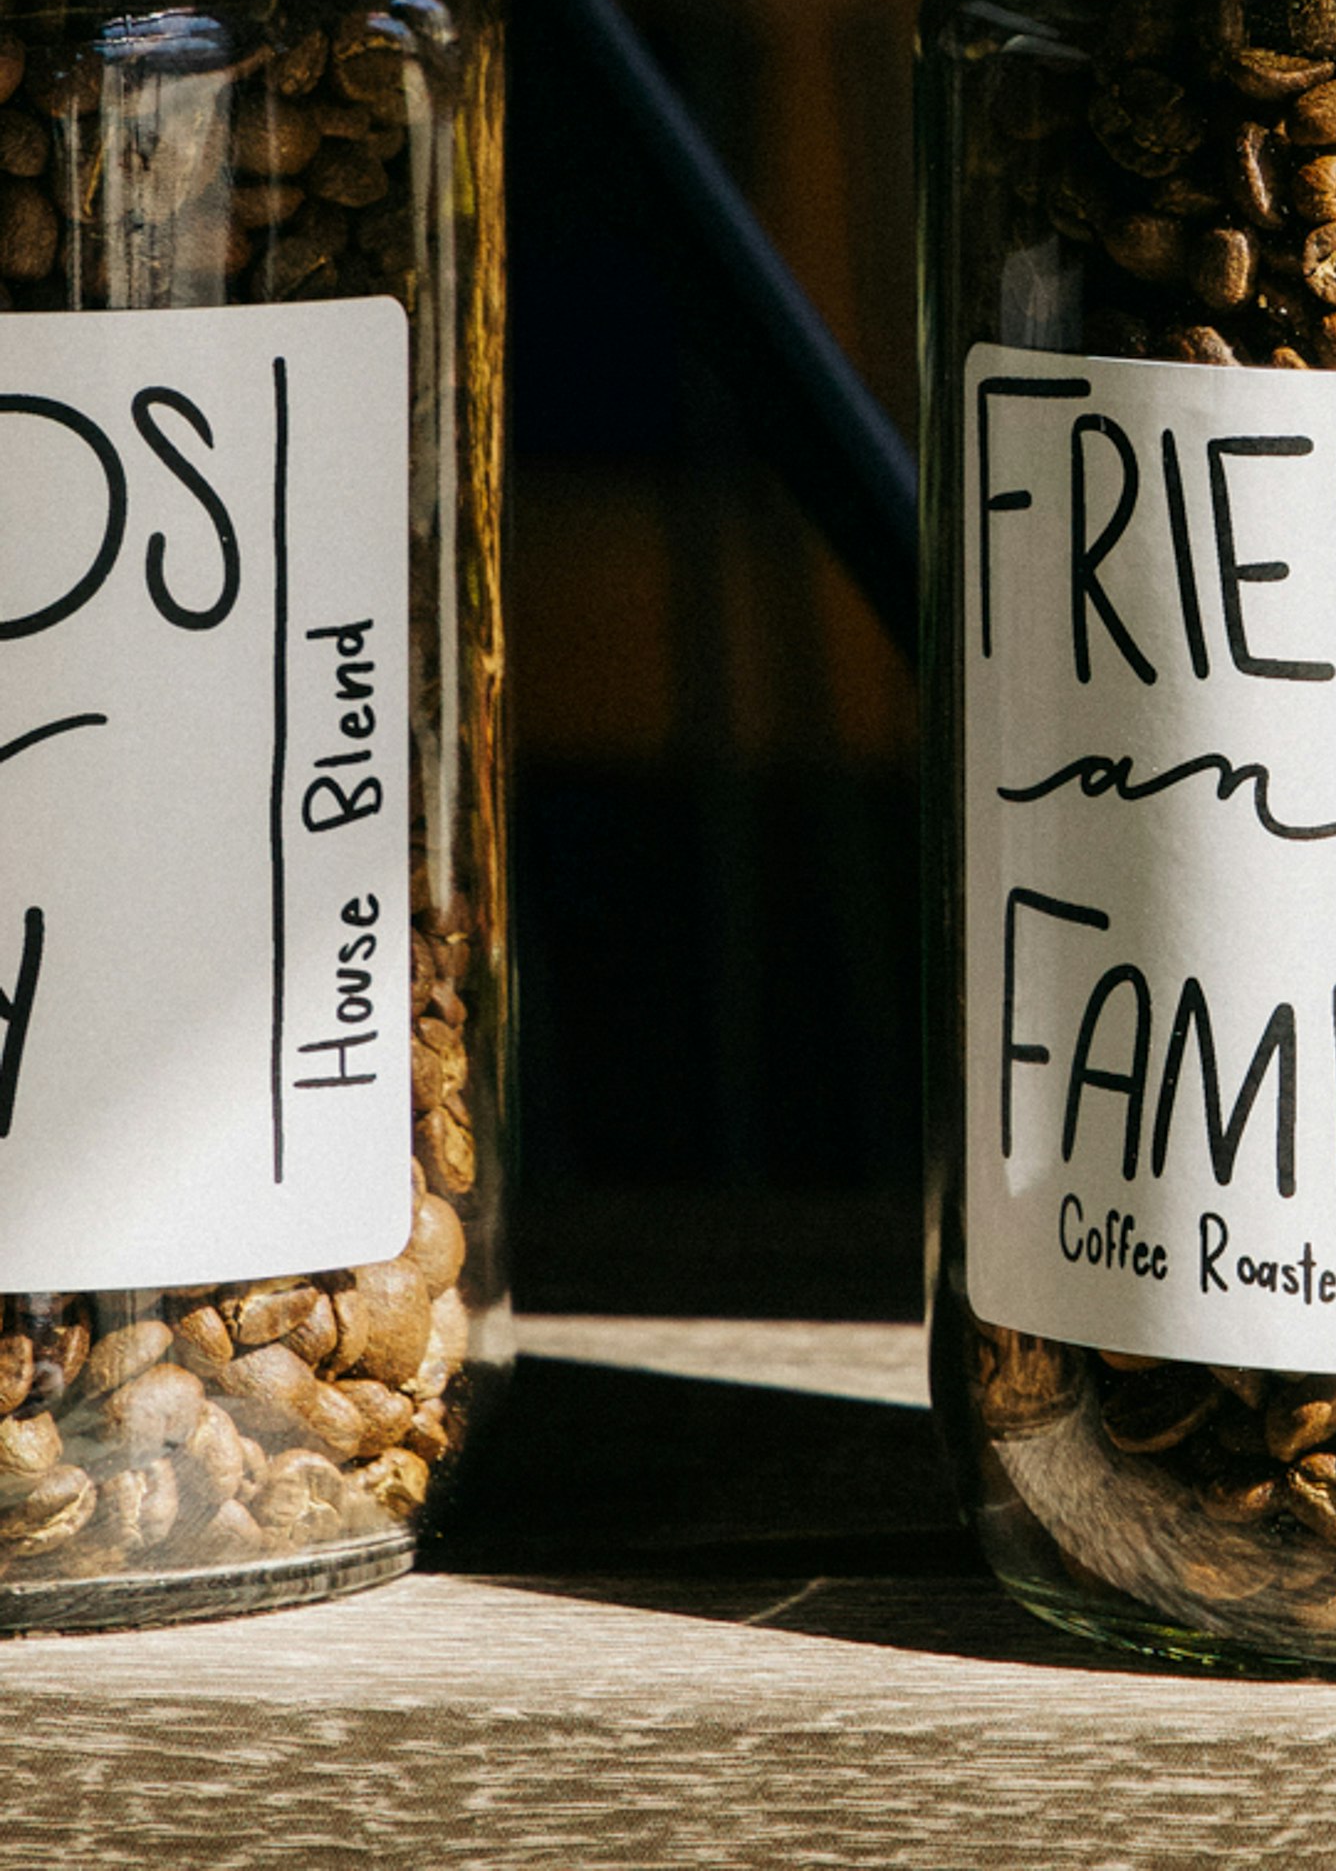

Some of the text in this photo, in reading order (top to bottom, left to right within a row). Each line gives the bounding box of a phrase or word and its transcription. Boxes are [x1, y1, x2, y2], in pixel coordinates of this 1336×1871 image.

[295, 618, 384, 1089] House Blend
[1059, 1193, 1168, 1280] Coffee
